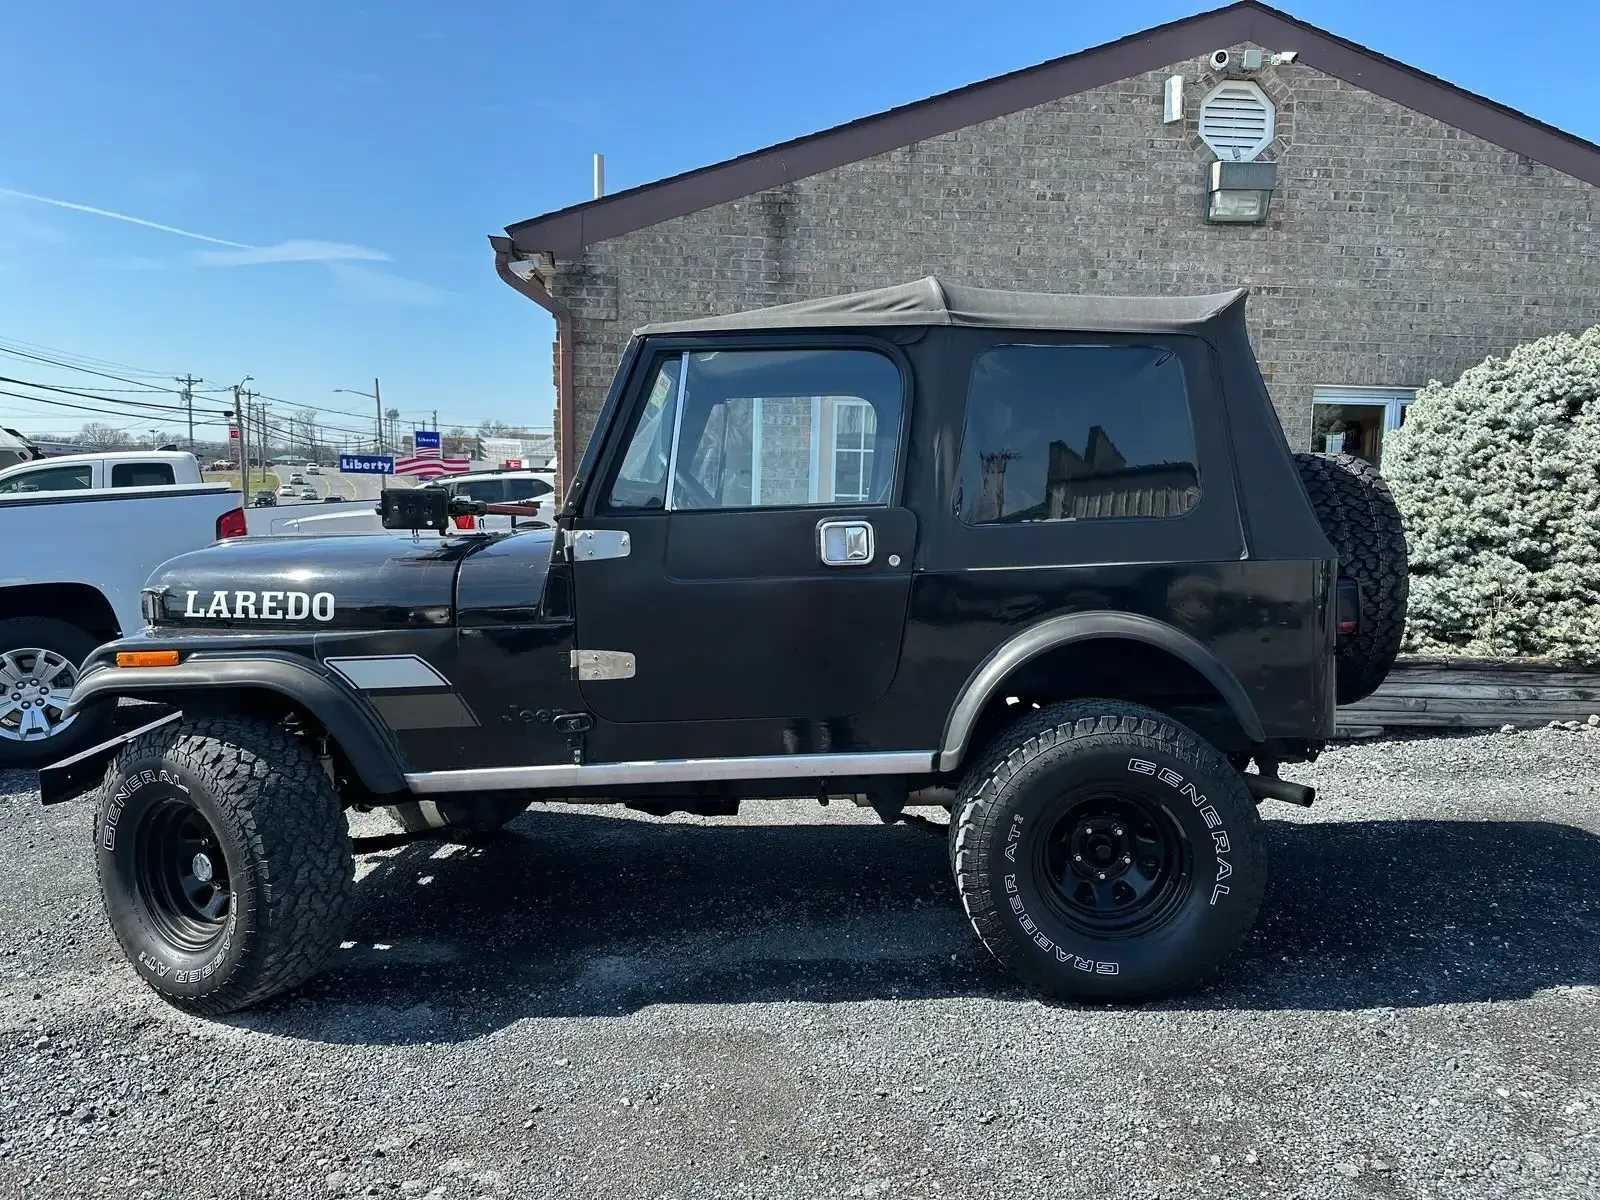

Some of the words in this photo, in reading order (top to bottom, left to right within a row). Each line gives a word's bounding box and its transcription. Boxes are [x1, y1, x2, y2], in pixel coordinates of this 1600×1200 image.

[341, 458, 391, 472] Liberty
[184, 590, 335, 621] LAREDO
[103, 769, 190, 851] GENERAL
[1127, 757, 1233, 906] GENERAL
[1004, 873, 1119, 975] GRABBER
